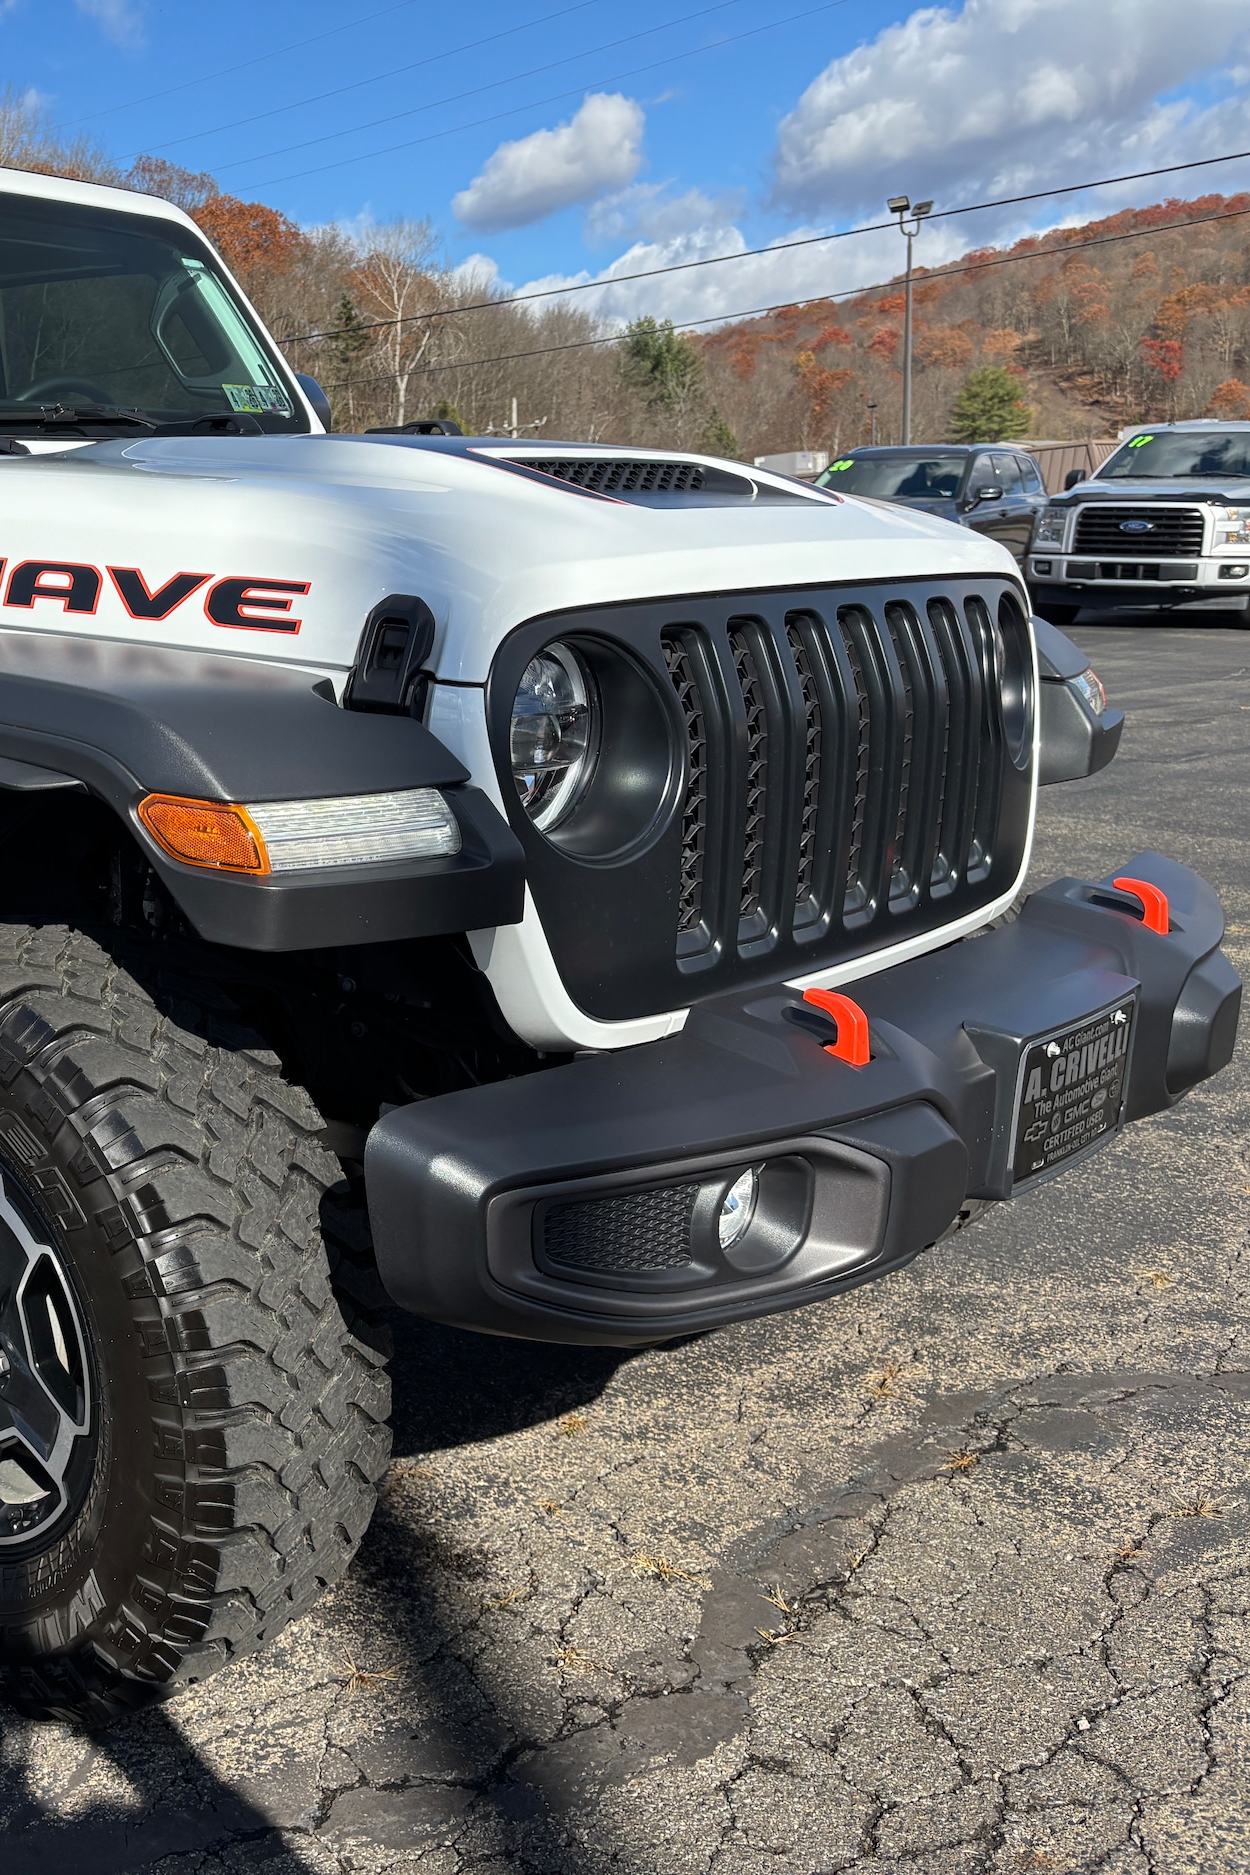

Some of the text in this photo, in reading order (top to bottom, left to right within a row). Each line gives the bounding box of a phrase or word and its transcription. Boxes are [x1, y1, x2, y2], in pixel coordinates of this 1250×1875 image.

[1128, 435, 1155, 448] 17
[828, 459, 856, 472] 20
[1024, 1066, 1048, 1104] A.
[1049, 1022, 1131, 1092] CRIVELLI
[1034, 1098, 1053, 1118] The
[1052, 1076, 1099, 1111] Automotive
[1100, 1064, 1118, 1088] Giant
[1063, 1097, 1090, 1124] GMC
[1043, 1109, 1104, 1152] CERTIFIED USED
